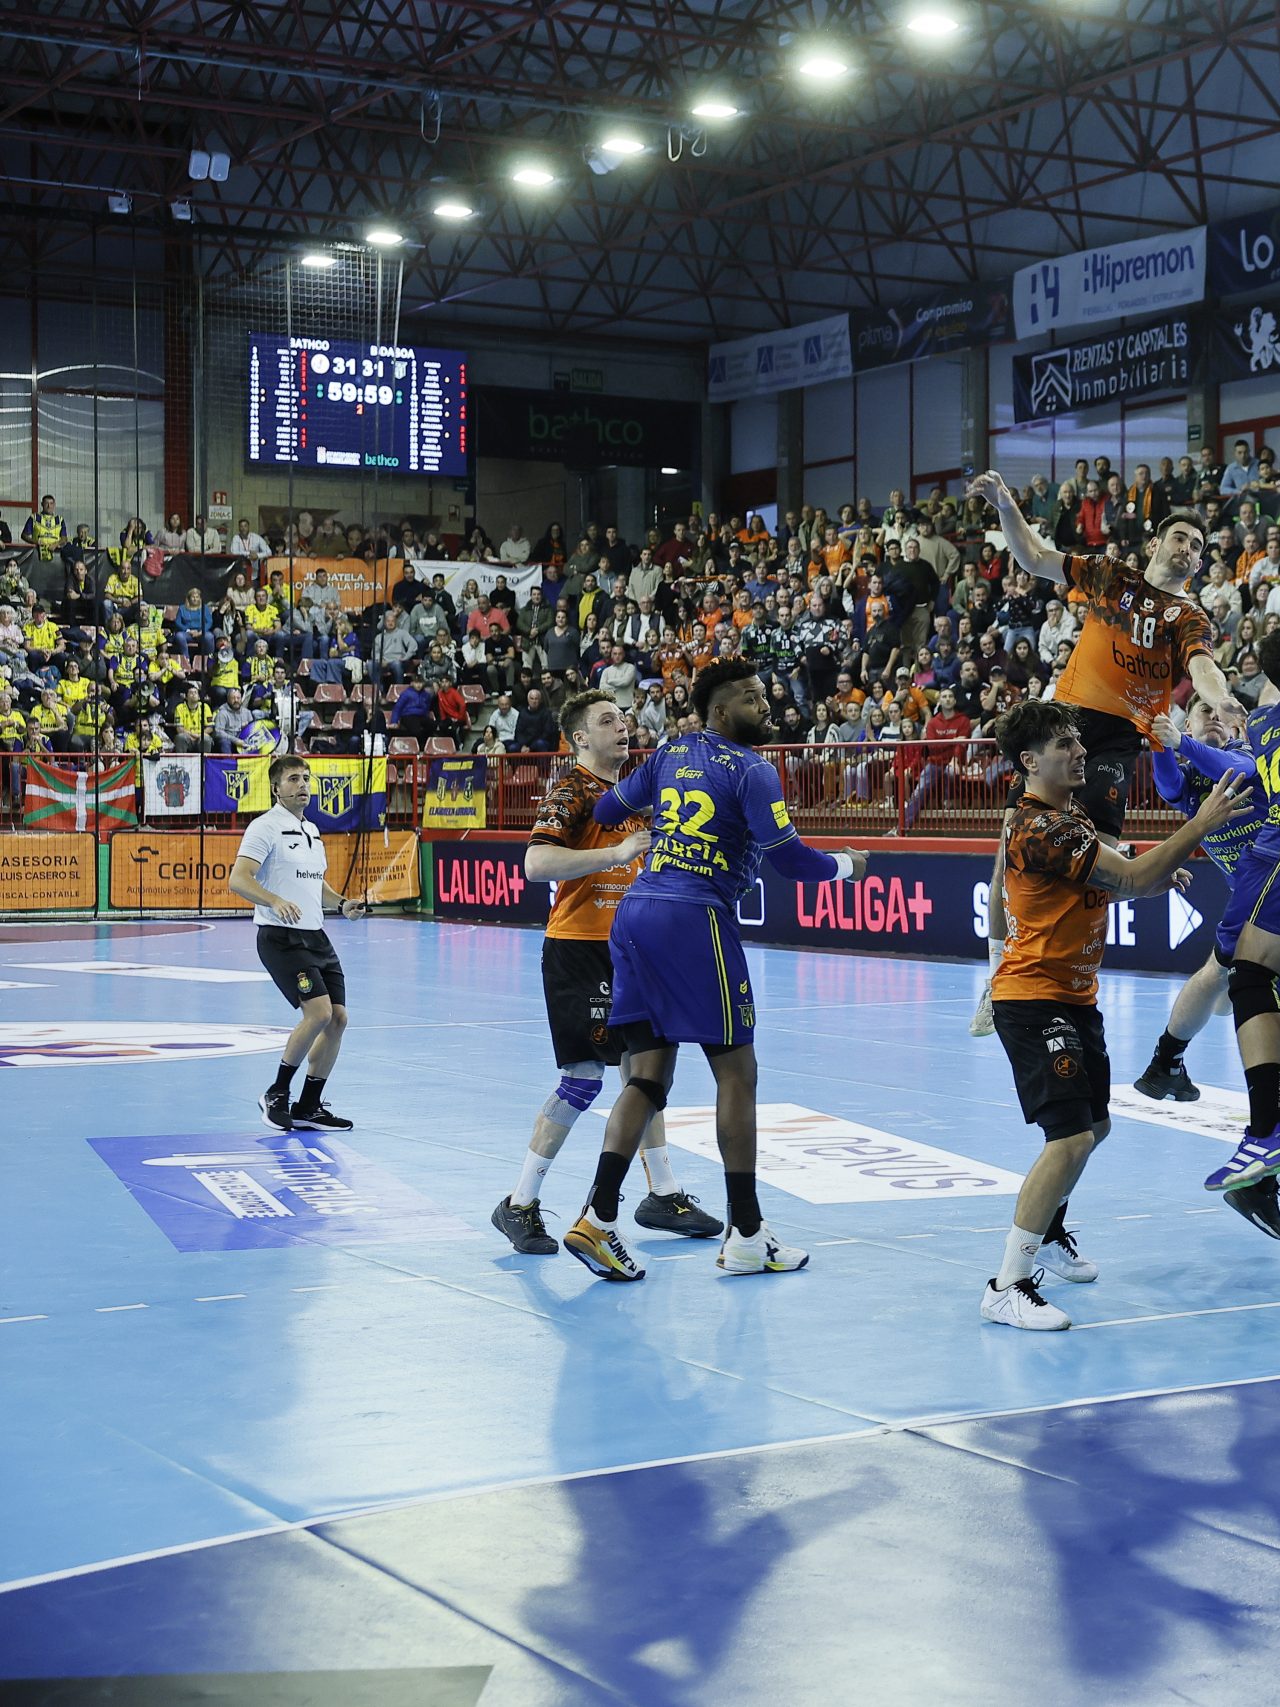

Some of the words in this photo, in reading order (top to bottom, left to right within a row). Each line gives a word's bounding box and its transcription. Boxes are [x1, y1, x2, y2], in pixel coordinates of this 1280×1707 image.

[1084, 245, 1195, 294] Hipremon
[916, 298, 973, 323] Compromiso
[370, 345, 416, 359] BDASOA
[1073, 340, 1115, 373] RENTAS
[1117, 335, 1125, 361] Y
[1129, 322, 1188, 359] CAPITALES
[333, 357, 356, 375] 31
[362, 359, 384, 377] 31
[1075, 355, 1188, 402] Inmobiliaria
[328, 381, 394, 405] 59:59
[354, 582, 383, 592] PISTA
[1130, 613, 1156, 649] 18
[1112, 641, 1170, 680] bathco
[656, 787, 719, 843] 32
[1, 855, 78, 867] ASESORIA
[0, 872, 22, 881] LUIS
[25, 871, 67, 881] CASERO
[69, 870, 81, 880] SL
[438, 859, 525, 906] LALIGA+
[0, 890, 80, 899] ISCAL-CONTABLE
[127, 885, 171, 895] Automotive
[796, 875, 933, 934] LALIGA+
